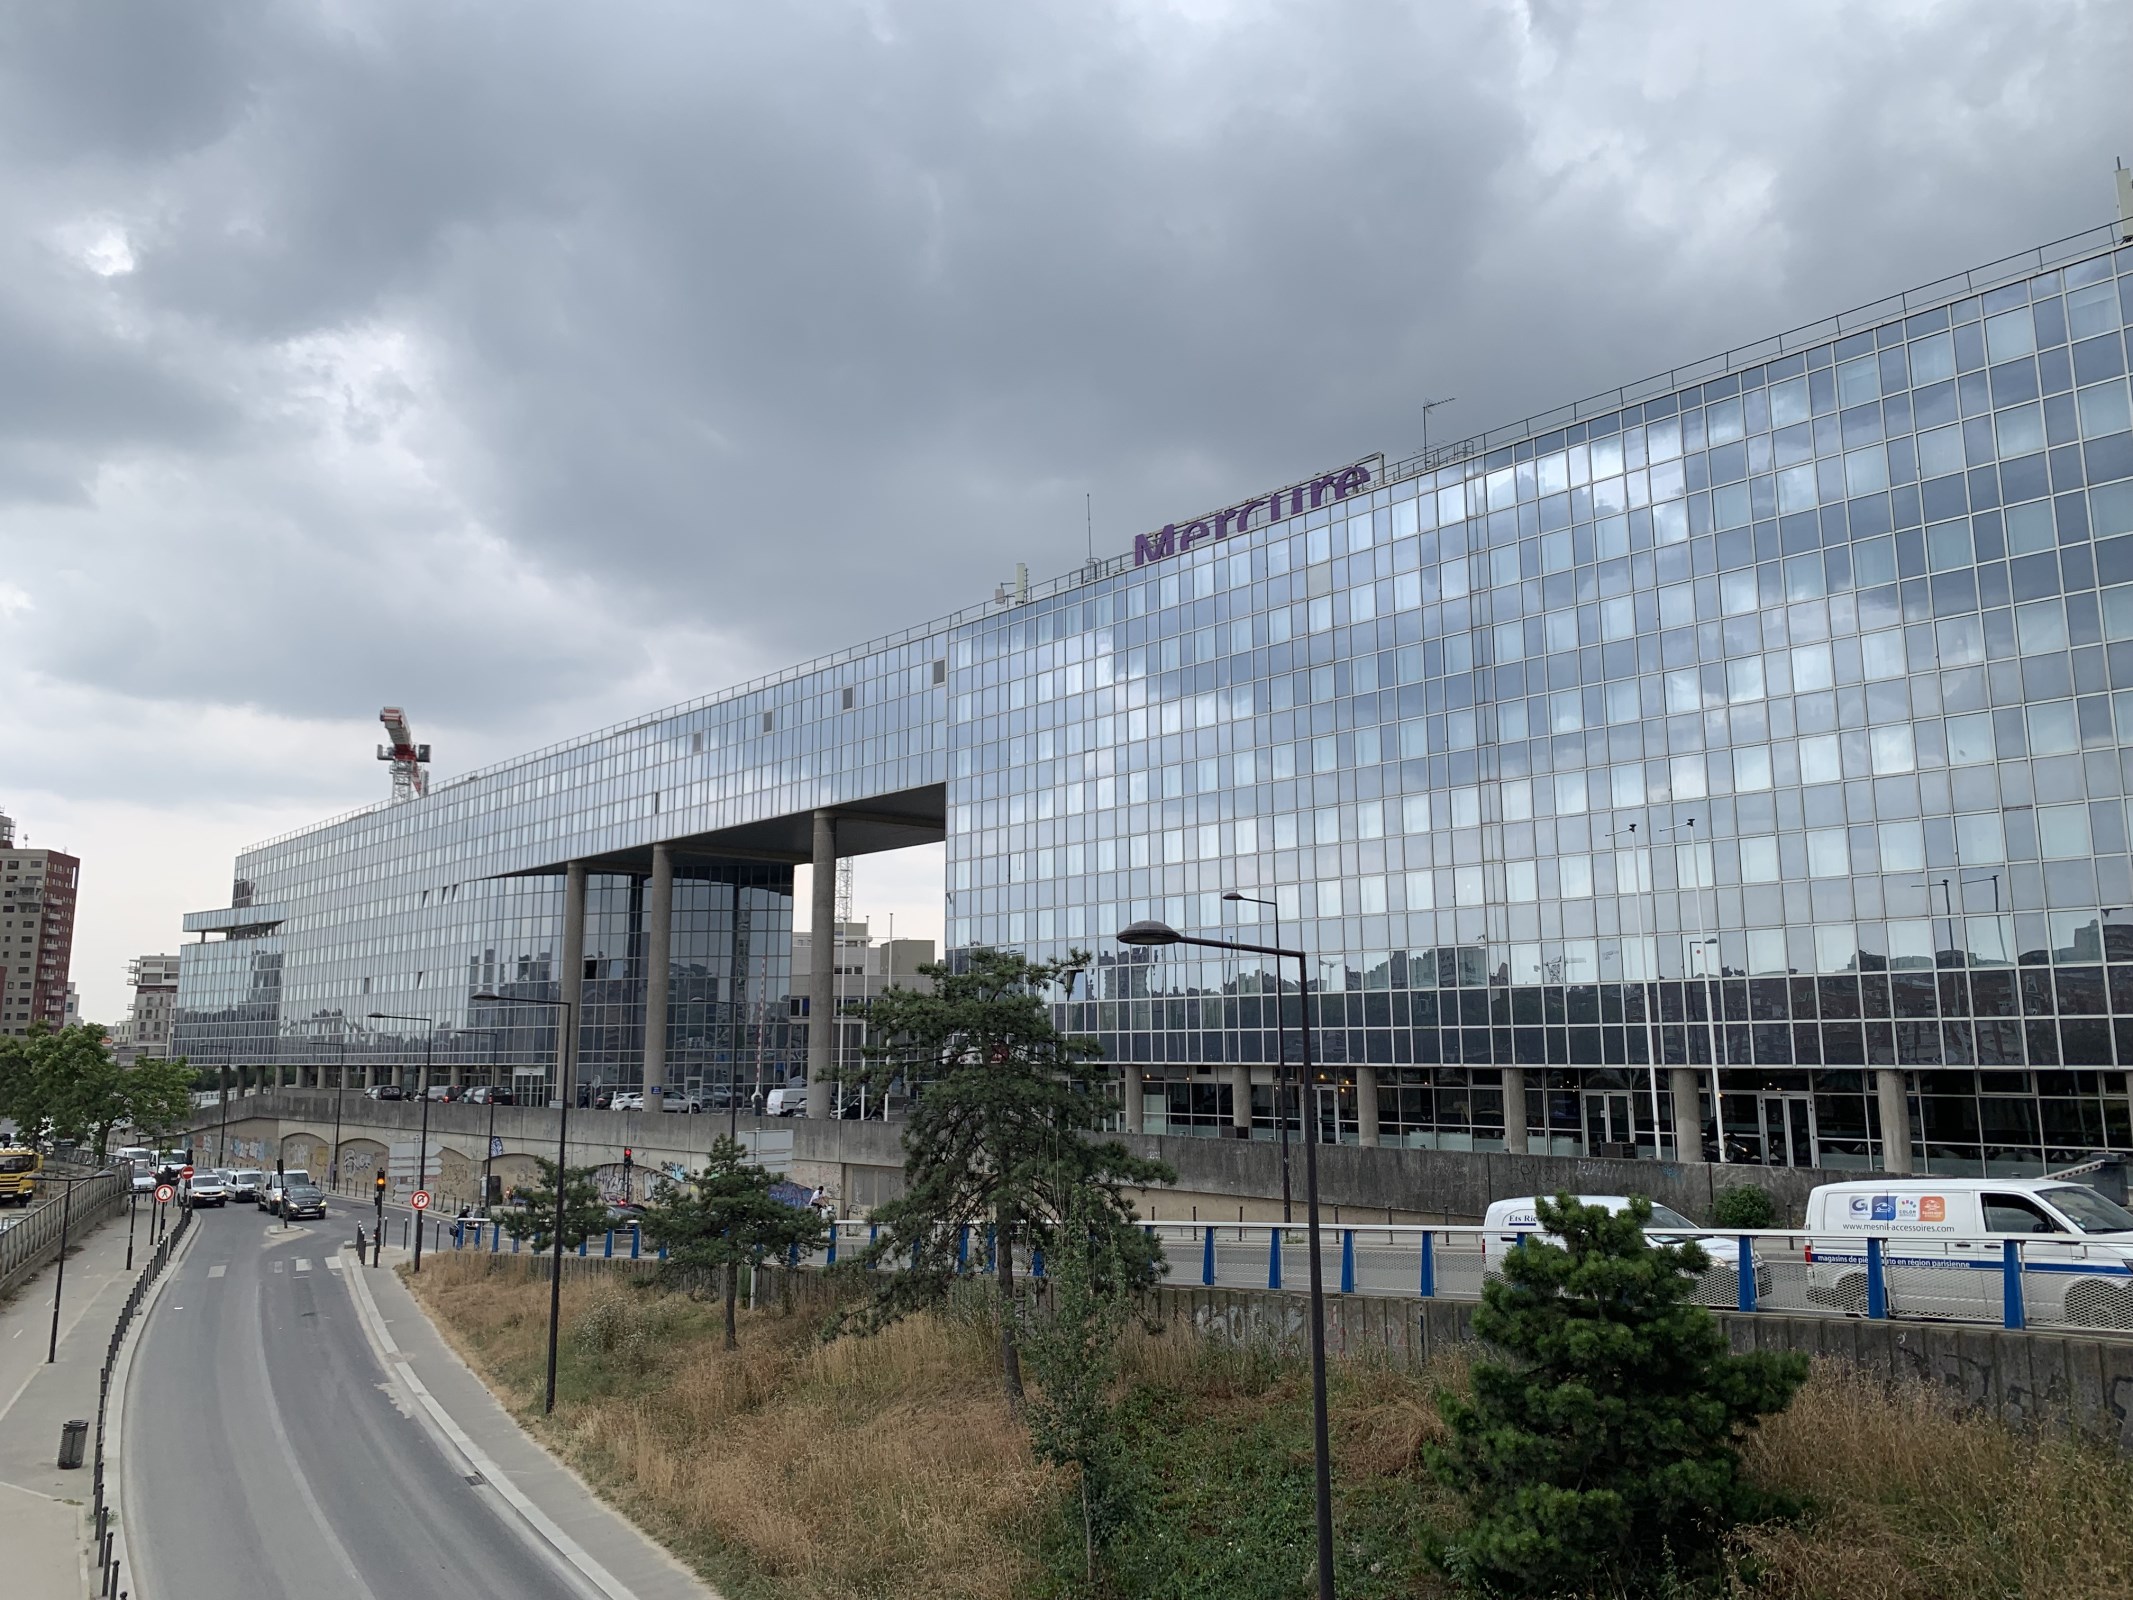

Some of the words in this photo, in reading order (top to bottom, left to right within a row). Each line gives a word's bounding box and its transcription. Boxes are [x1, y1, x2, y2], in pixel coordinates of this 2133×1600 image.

[1134, 466, 1370, 567] Mercure
[1509, 1214, 1522, 1222] Ets
[1843, 1222, 1955, 1233] www.mesnil-accessoires.com
[1817, 1255, 1848, 1263] magasins
[1907, 1259, 1931, 1267] région
[1931, 1260, 1971, 1269] parisienne
